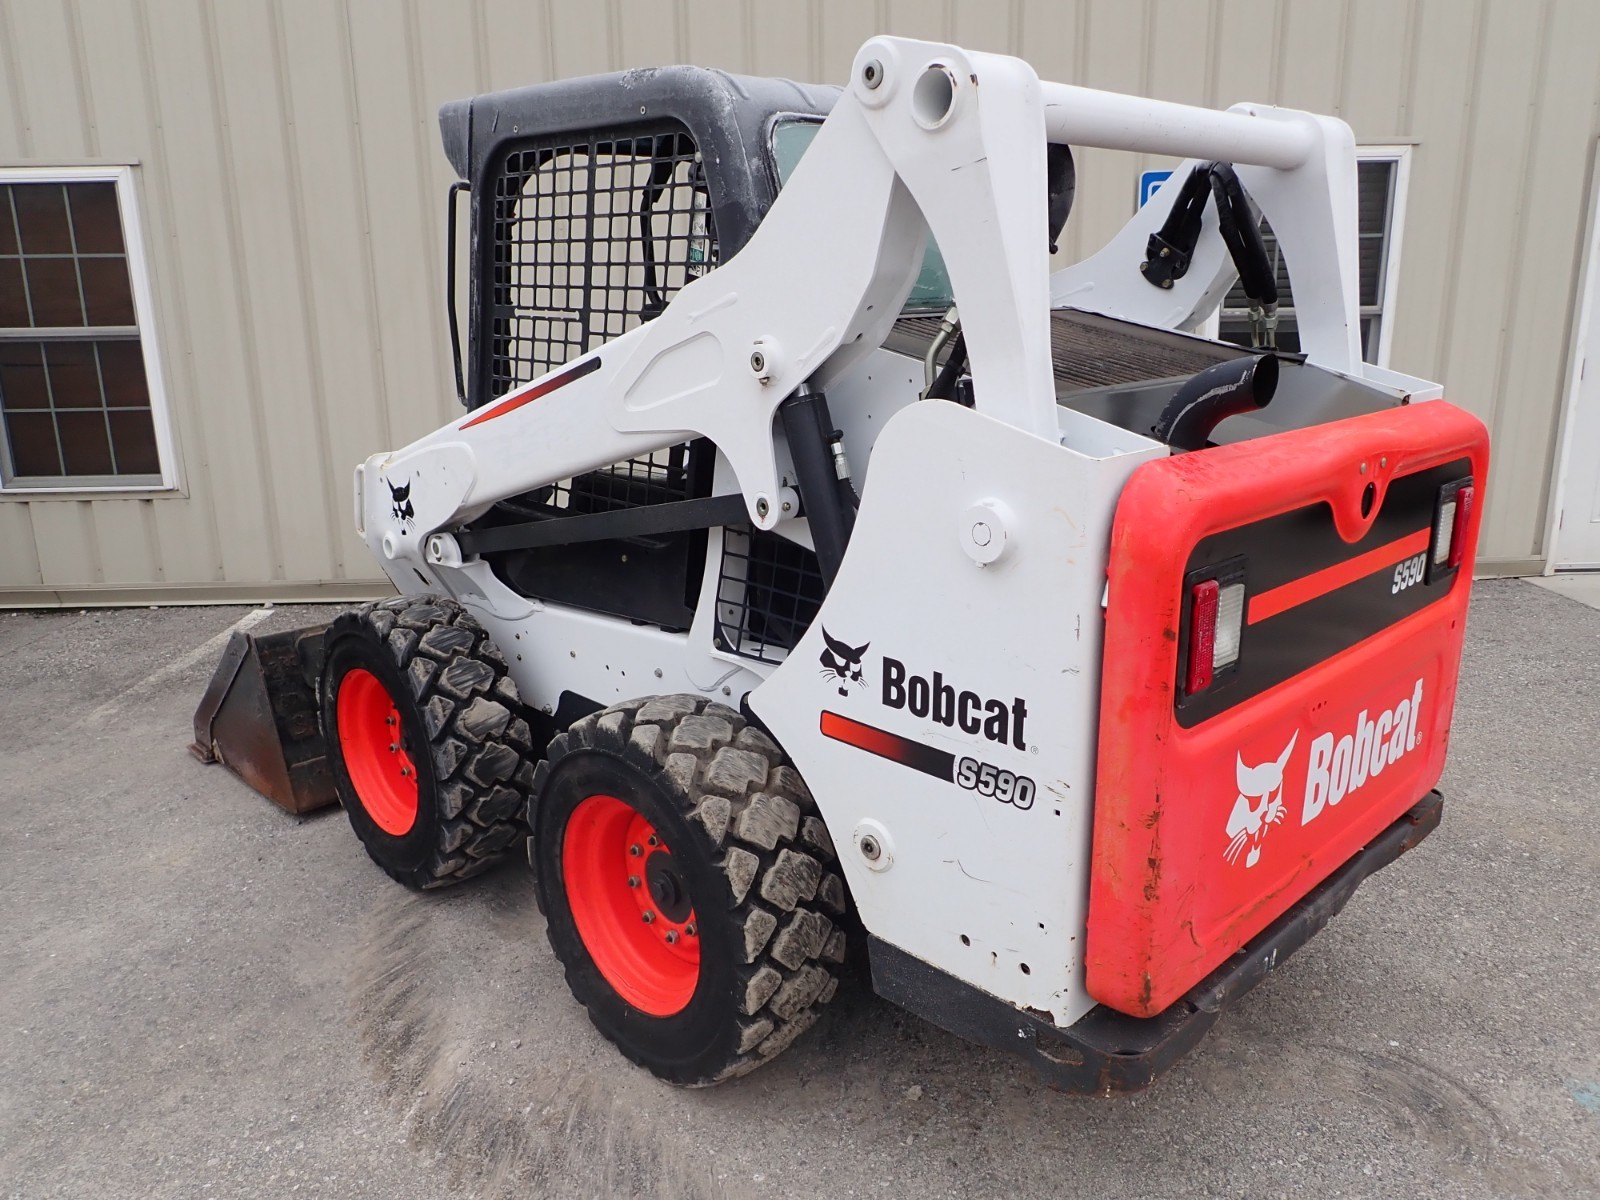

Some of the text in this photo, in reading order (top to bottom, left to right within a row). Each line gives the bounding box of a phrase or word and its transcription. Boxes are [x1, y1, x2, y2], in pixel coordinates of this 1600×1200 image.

[1392, 553, 1427, 594] S590
[882, 656, 1028, 751] Bobcat
[957, 756, 1036, 811] S590
[1301, 678, 1424, 826] Bobcat
